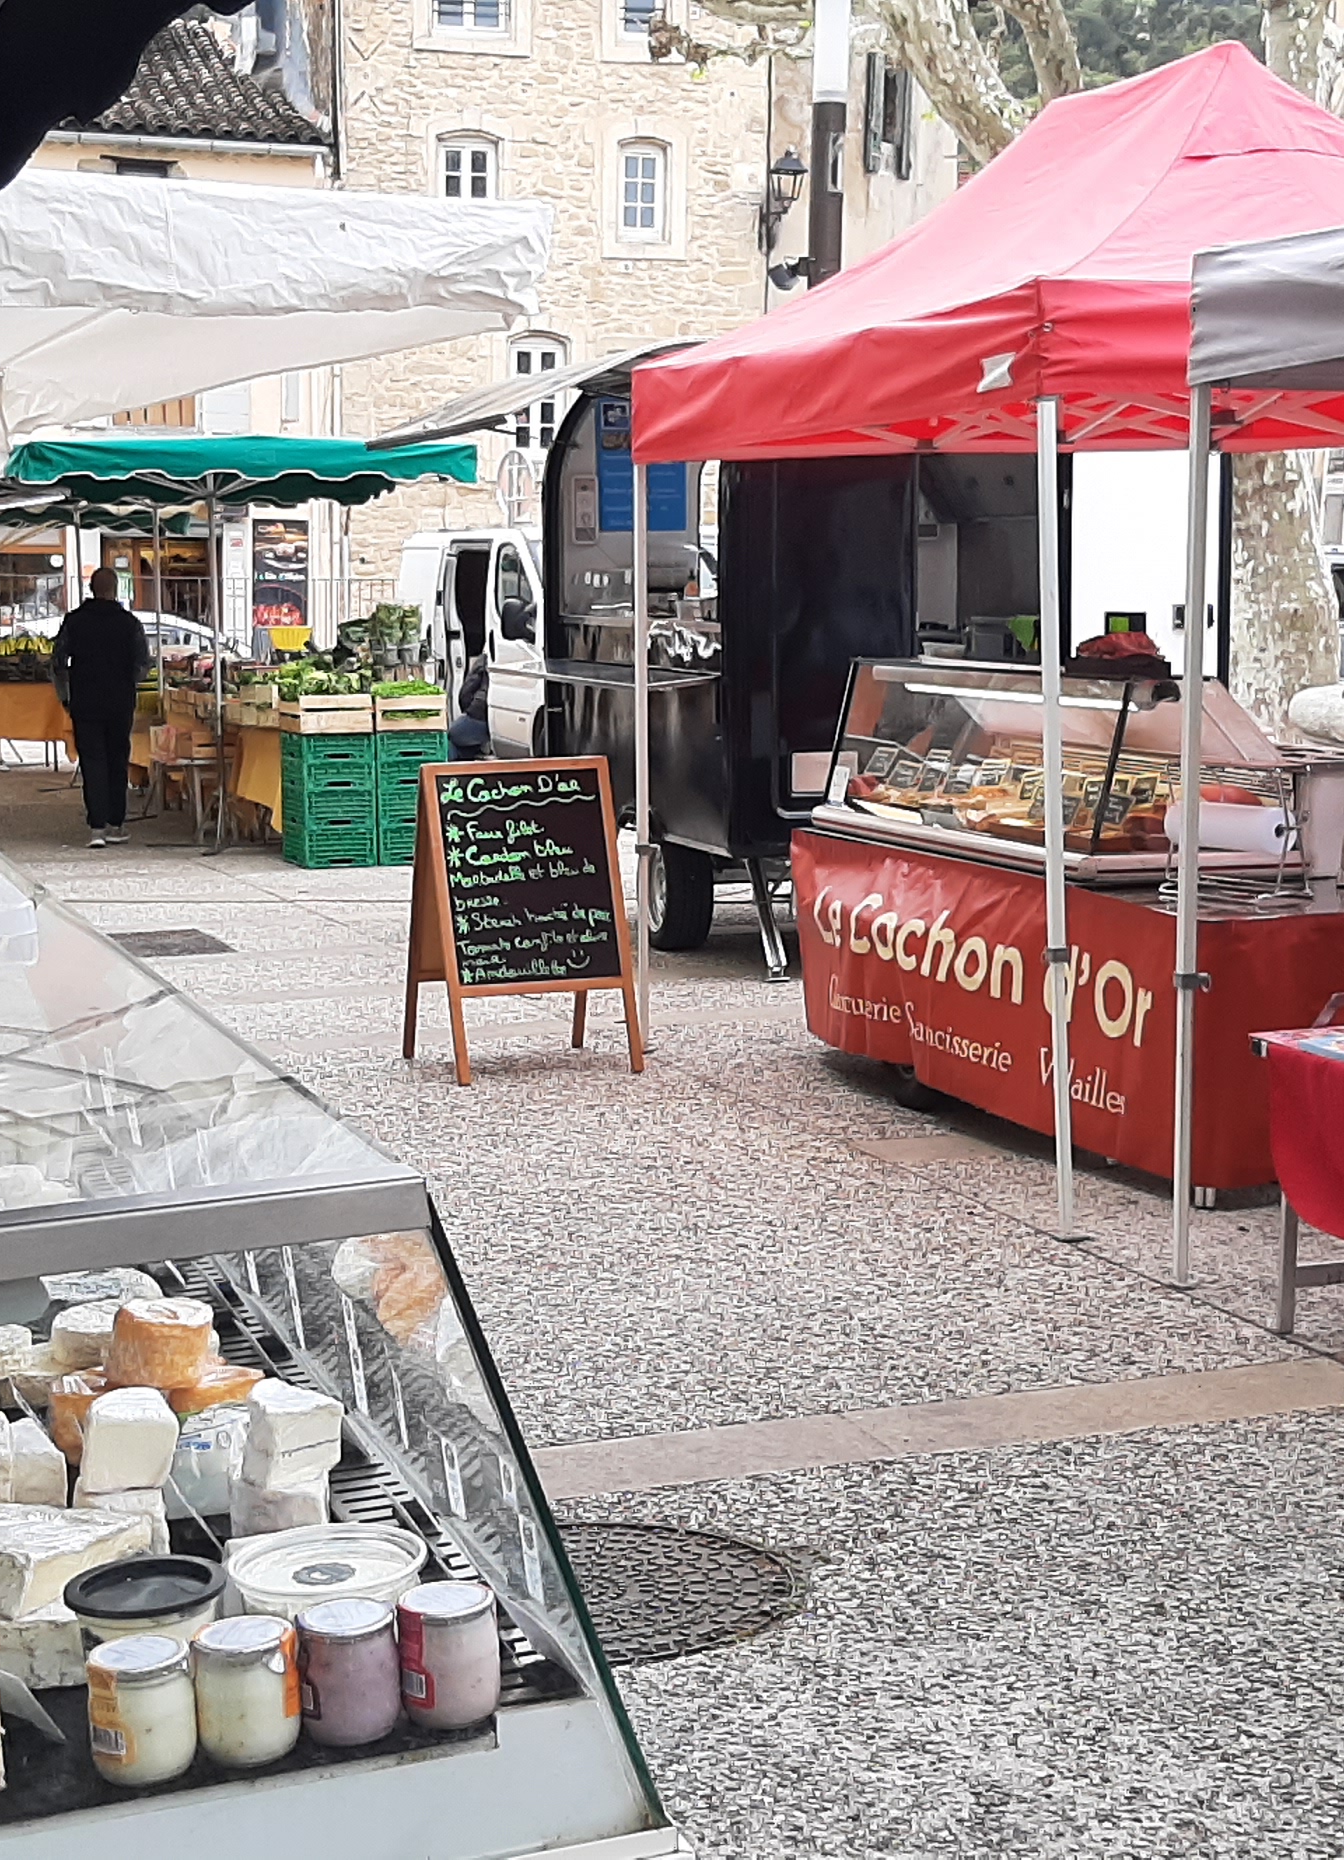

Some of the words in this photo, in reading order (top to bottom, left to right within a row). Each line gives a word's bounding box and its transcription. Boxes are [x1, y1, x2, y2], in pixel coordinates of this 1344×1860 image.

[441, 777, 464, 803] Le
[466, 777, 534, 802] Cochon
[813, 885, 843, 949] Le
[849, 892, 1024, 1006] Cochon
[1043, 944, 1153, 1048] d'Or
